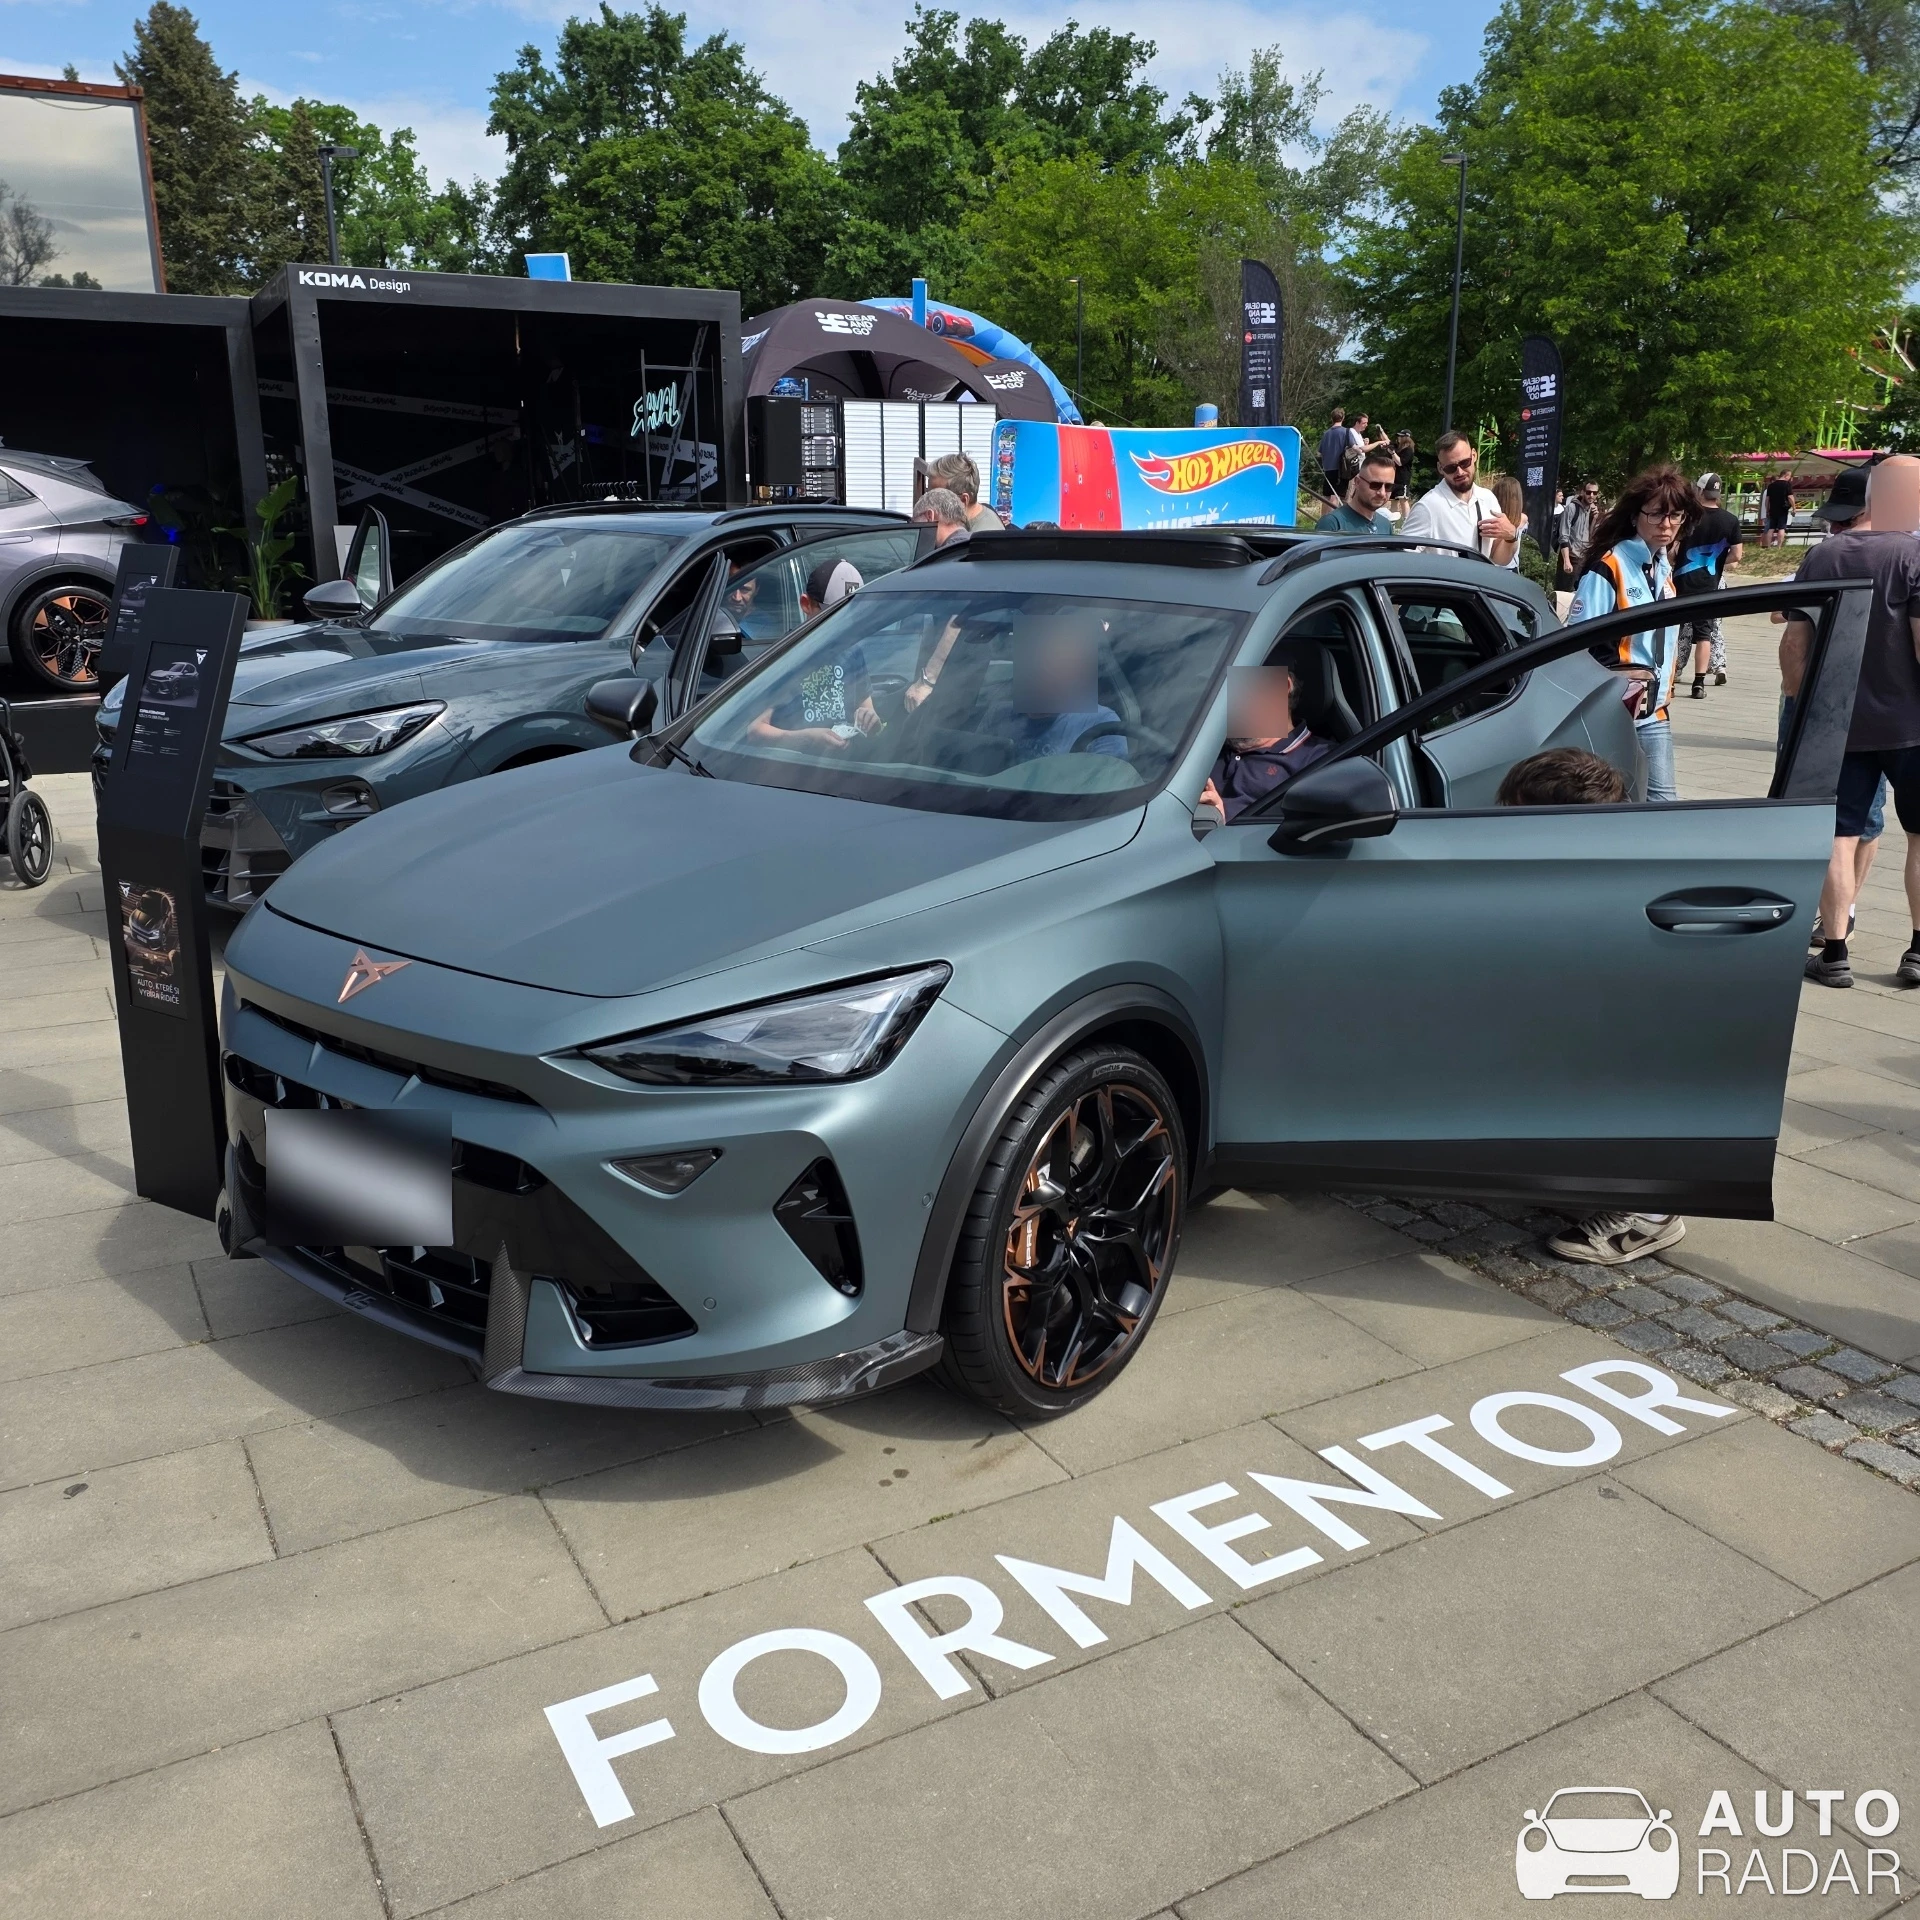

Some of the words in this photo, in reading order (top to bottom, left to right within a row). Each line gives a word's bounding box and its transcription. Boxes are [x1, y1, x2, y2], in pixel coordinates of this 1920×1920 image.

[299, 271, 366, 289] KOMA
[370, 278, 410, 293] Design
[844, 314, 878, 322] GEAR
[850, 320, 873, 328] AND
[544, 1358, 1738, 1828] FORMENTOR
